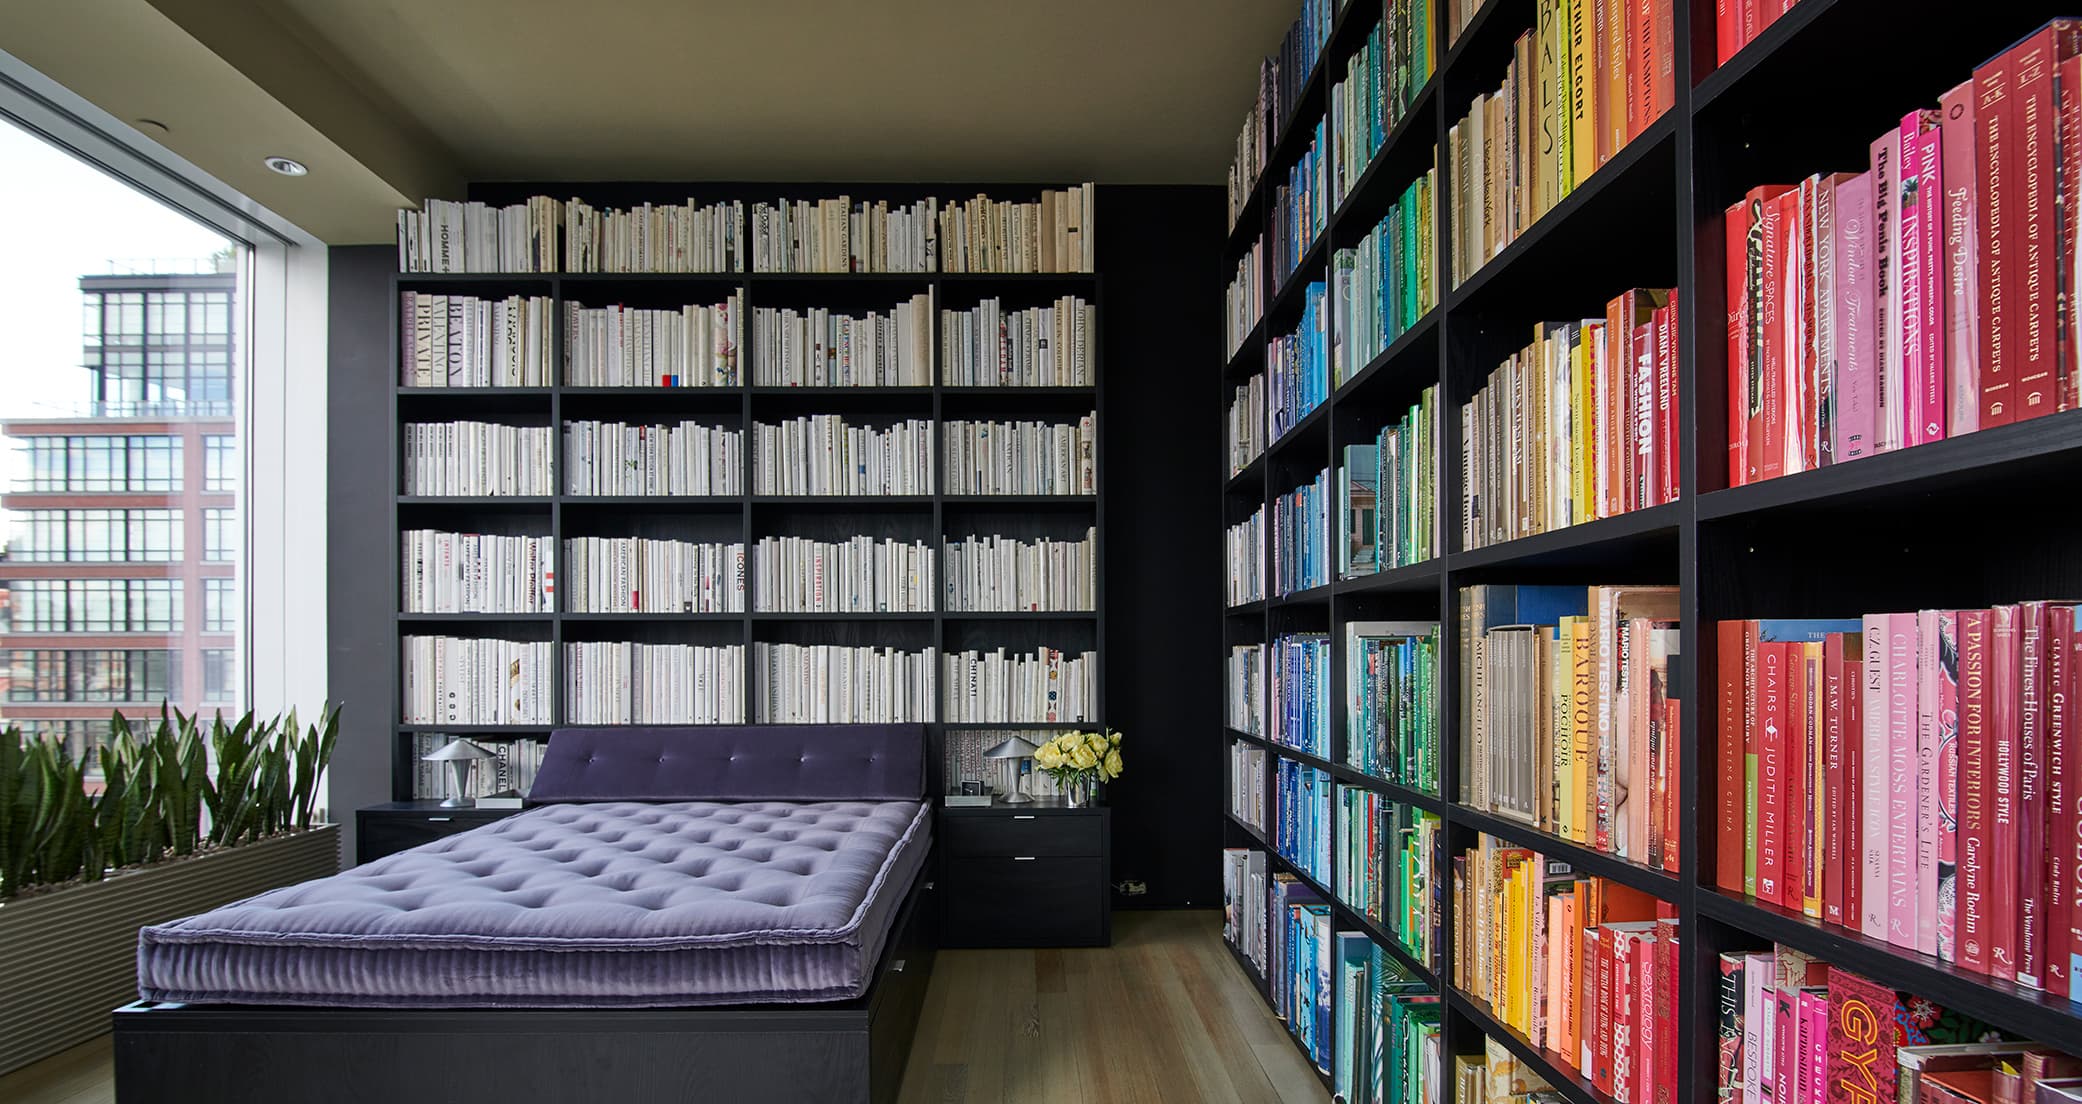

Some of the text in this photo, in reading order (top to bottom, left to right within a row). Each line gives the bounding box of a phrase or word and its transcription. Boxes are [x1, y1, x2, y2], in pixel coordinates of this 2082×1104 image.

[1573, 0, 1584, 121] THUR ELGORT
[2020, 66, 2040, 83] L-Z
[1921, 142, 1936, 185] PINK
[440, 224, 450, 274] HOMME+
[840, 203, 848, 231] ITALIAN
[1877, 147, 1888, 298] The Big Penis Book
[1901, 131, 1920, 356] Bailey INSPIRATIONS
[1948, 187, 1969, 296] Feeding Desire
[1988, 116, 2001, 372] THE ENCYCLOPEDIA OF ANTIQUE CARPETS
[2026, 94, 2039, 361] THE ENCYCLOPEDIA OF ANTIQUE CARPETS
[1762, 205, 1780, 324] Signature SPACES
[1819, 189, 1832, 395] NEW YORK APARTMENTS
[1844, 218, 1862, 372] Window Treatments
[417, 304, 431, 378] PRIVATE
[433, 300, 446, 374] VALENTINO
[449, 303, 463, 377] BEATON
[1077, 309, 1085, 375] JOHN DERIAN
[1659, 324, 1669, 411] DIANA VREELAND
[1638, 354, 1653, 456] FASHION
[736, 552, 746, 592] ICONES
[1599, 601, 1610, 656] MARIO
[1869, 626, 1880, 649] CZ
[1476, 640, 1484, 744] MICHELANGELO
[1575, 638, 1590, 764] BAROQUE
[1599, 661, 1610, 732] TESTINO
[1622, 660, 1630, 697] TESTINO
[1869, 651, 1881, 693] GUEST
[1561, 694, 1569, 767] POCHOIR
[1829, 675, 1838, 769] J.M.W. TURNER
[2023, 625, 2039, 801] The Finest Houses of Paris
[2052, 638, 2064, 815] CLASSIC GREENWICH STYLE
[498, 746, 507, 791] CHANEL
[1765, 654, 1777, 866] CHAIRS JUDITH MILLER
[1892, 633, 1907, 907] CHARLOTTE MOSS ENTERTAINS
[1920, 713, 1932, 870] THE GARDENER'S LIFE
[1963, 617, 1982, 933] A PASSION FOR INTERIORS Carolyne Roehm
[1997, 740, 2010, 825] HOLLYWOOD STYLE
[1600, 958, 1609, 968] THE
[2024, 898, 2033, 973] The Vendome Press
[1600, 990, 1609, 1004] BOOK
[1642, 962, 1653, 1050] Sextrology
[1720, 974, 1738, 1018] THIS
[1600, 1030, 1609, 1041] AND
[1600, 1041, 1609, 1058] DYING
[1746, 1030, 1758, 1101] BESPOKE
